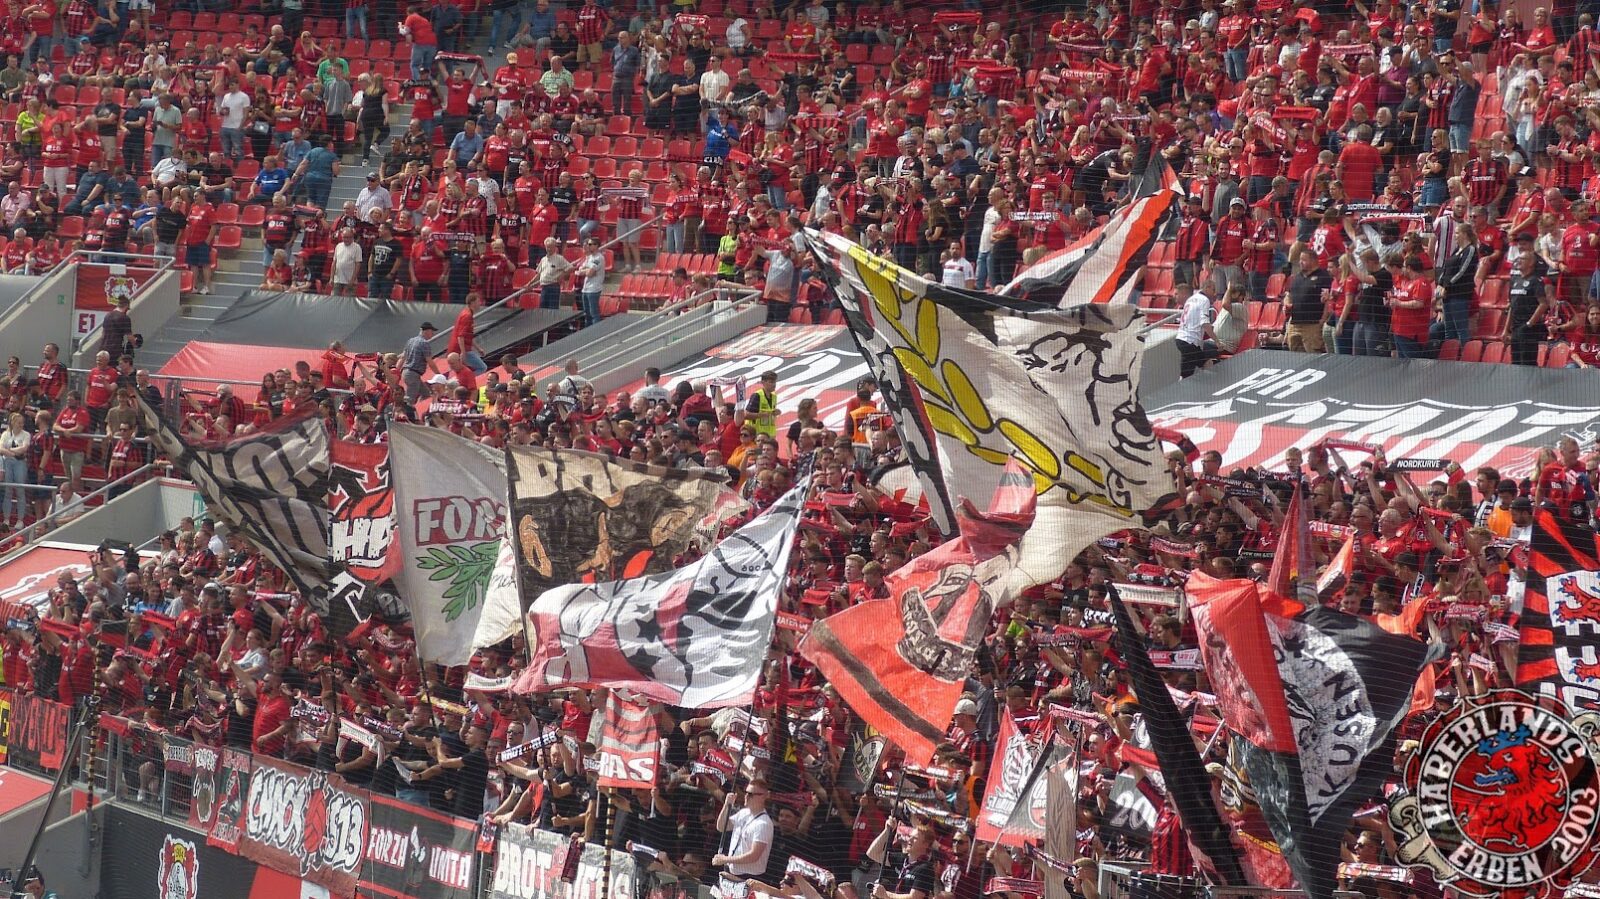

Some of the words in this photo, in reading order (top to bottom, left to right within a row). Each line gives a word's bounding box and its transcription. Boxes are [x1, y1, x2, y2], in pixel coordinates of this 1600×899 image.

[79, 313, 96, 333] E1
[1397, 460, 1440, 468] NORDKURVE
[367, 827, 409, 869] FORZA
